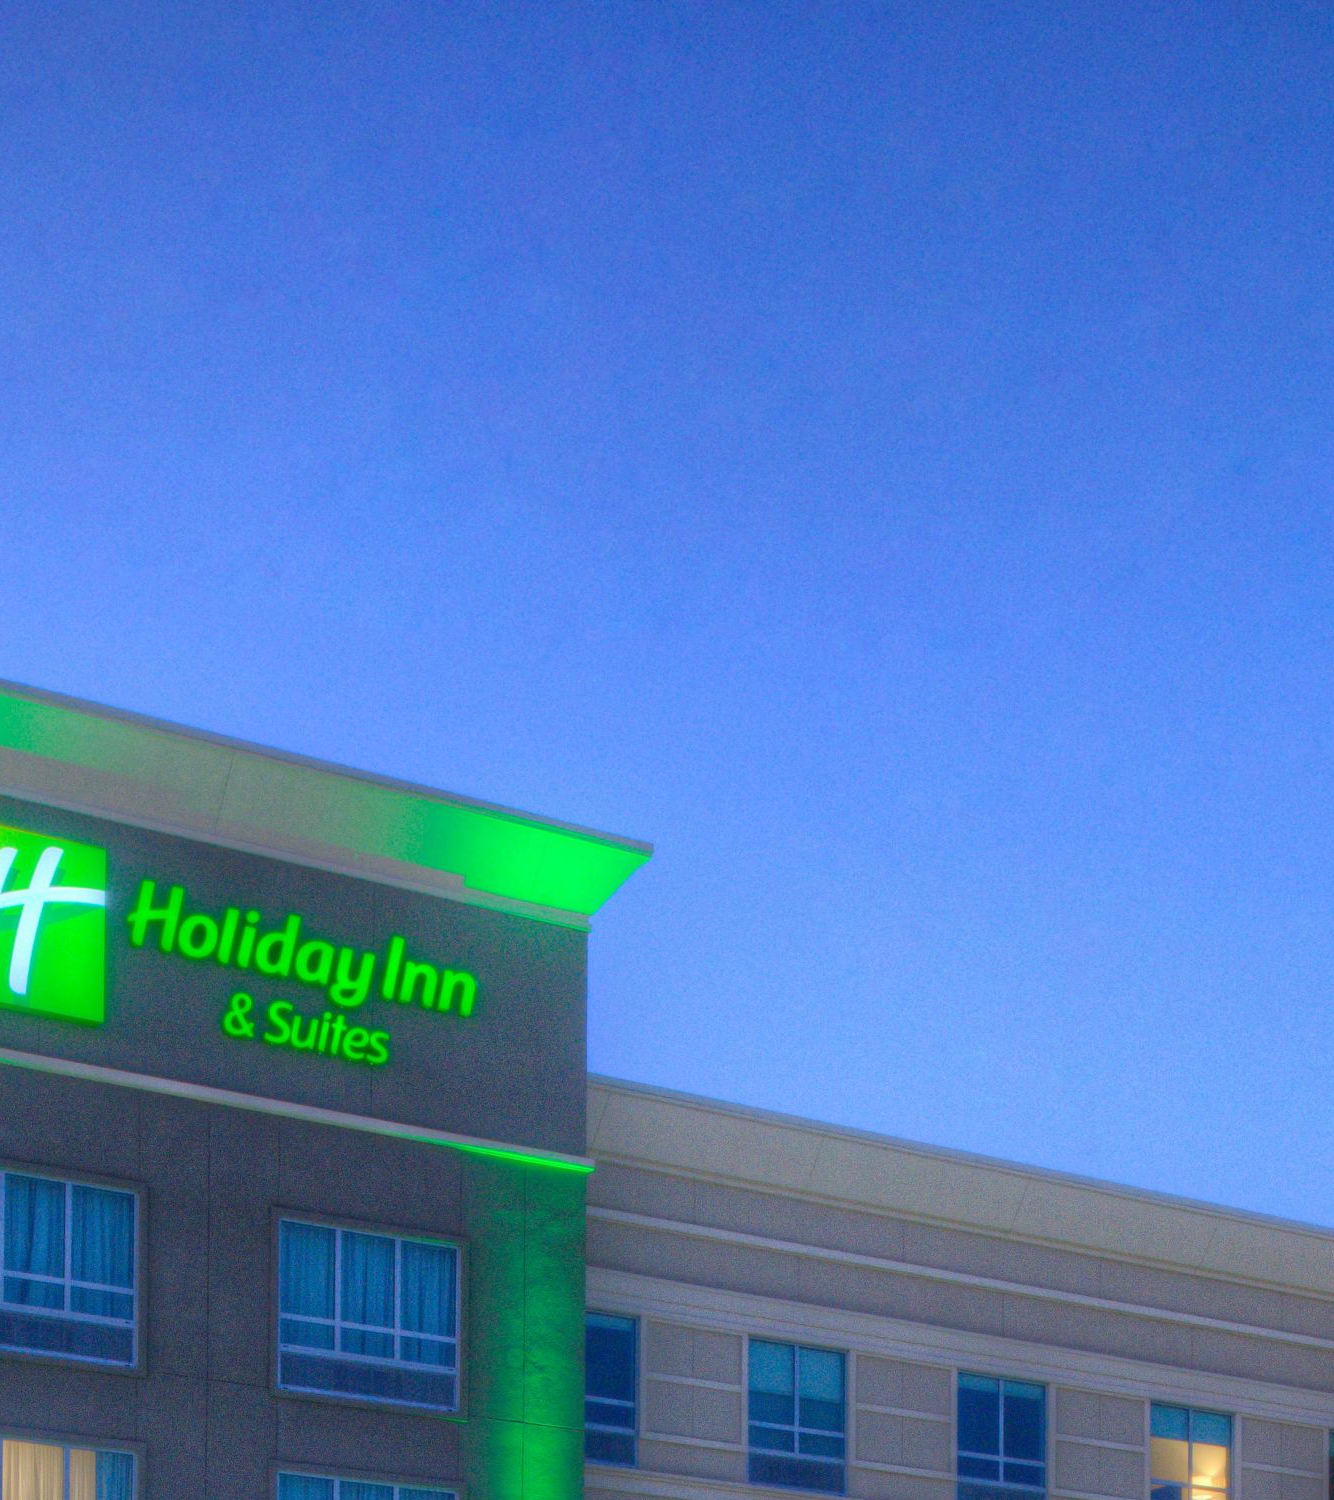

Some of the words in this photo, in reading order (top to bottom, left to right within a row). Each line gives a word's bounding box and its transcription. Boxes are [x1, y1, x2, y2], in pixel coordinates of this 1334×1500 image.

[127, 879, 375, 1008] Holiday
[381, 935, 478, 1018] Inn
[222, 992, 255, 1039] &
[264, 1000, 391, 1065] Suites
